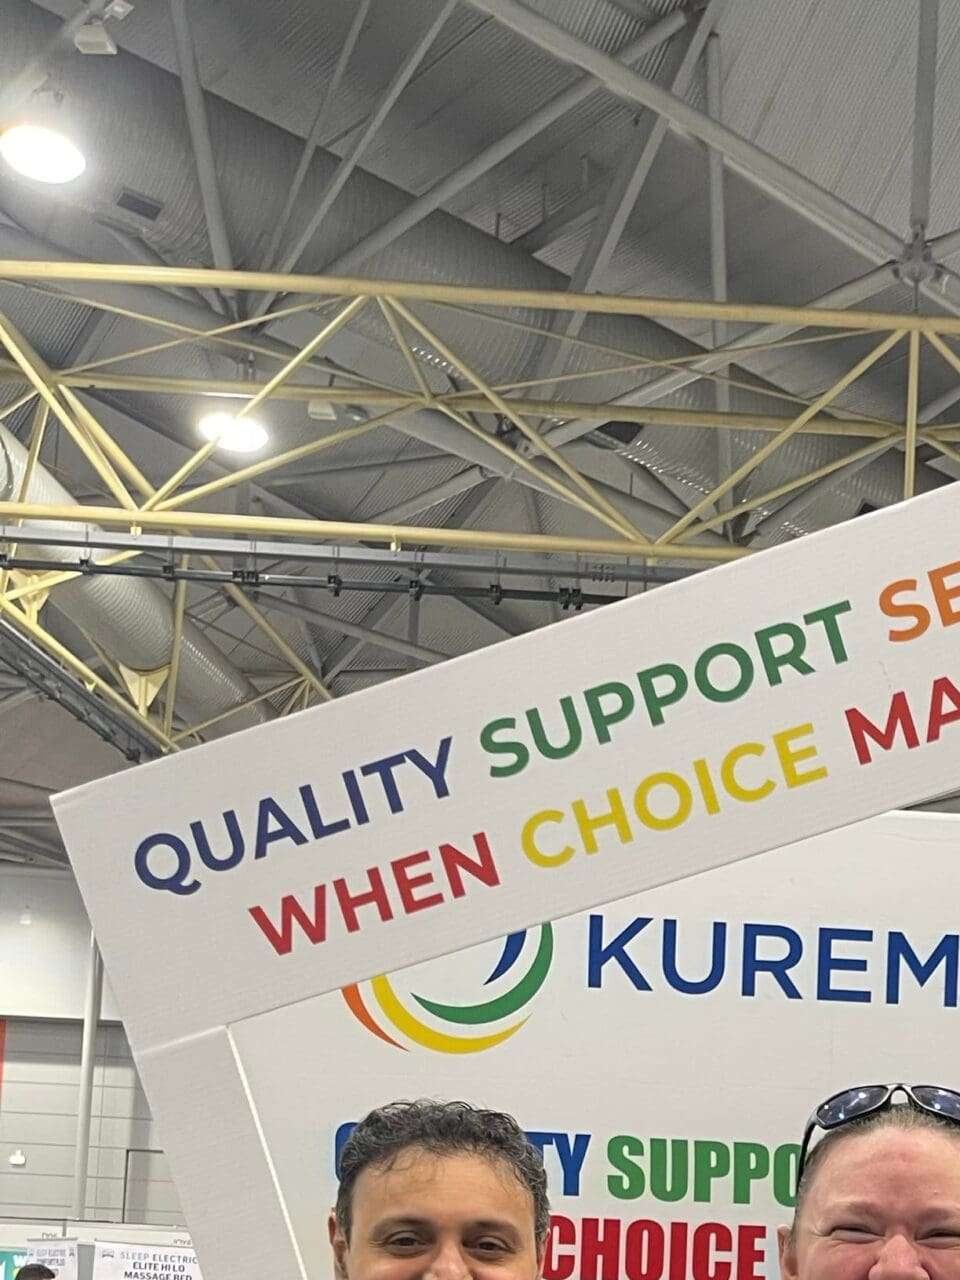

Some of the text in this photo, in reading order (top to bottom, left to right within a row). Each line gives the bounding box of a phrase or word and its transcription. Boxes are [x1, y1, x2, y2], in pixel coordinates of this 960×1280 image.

[135, 738, 455, 893] QUALITY
[482, 600, 852, 774] SUPPORT
[249, 831, 500, 955] WHEN
[521, 723, 828, 868] CHOICE
[607, 1135, 802, 1207] SUPPO
[120, 1251, 198, 1264] SLEEP ELECTRIC
[124, 1271, 171, 1280] MASSAGE
[133, 1261, 185, 1272] ELITE HI LO
